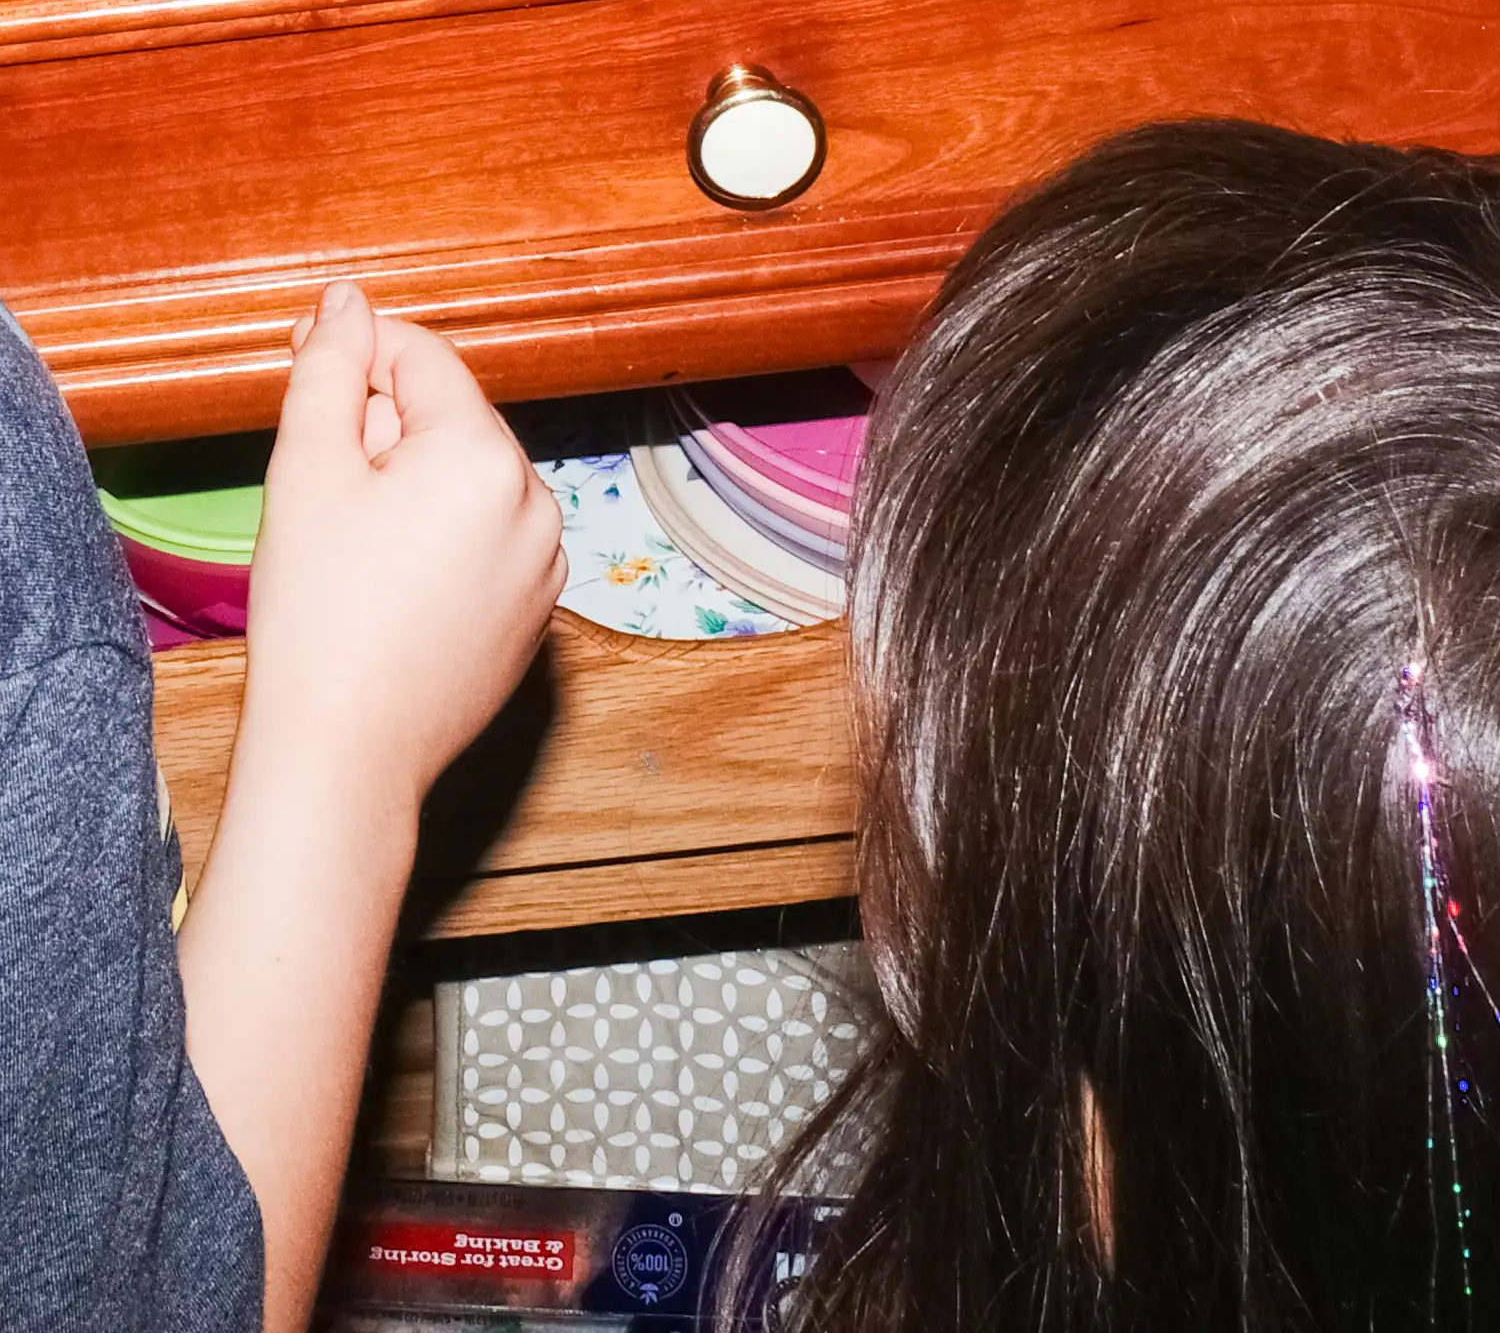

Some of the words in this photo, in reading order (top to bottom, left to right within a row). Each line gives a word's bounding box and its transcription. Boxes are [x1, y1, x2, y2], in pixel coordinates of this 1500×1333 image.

[454, 1234, 541, 1253] Baking
[545, 1240, 564, 1254] &
[369, 1246, 457, 1266] Storing
[461, 1252, 495, 1268] for
[498, 1253, 564, 1270] Great
[630, 1253, 669, 1272] 100%
